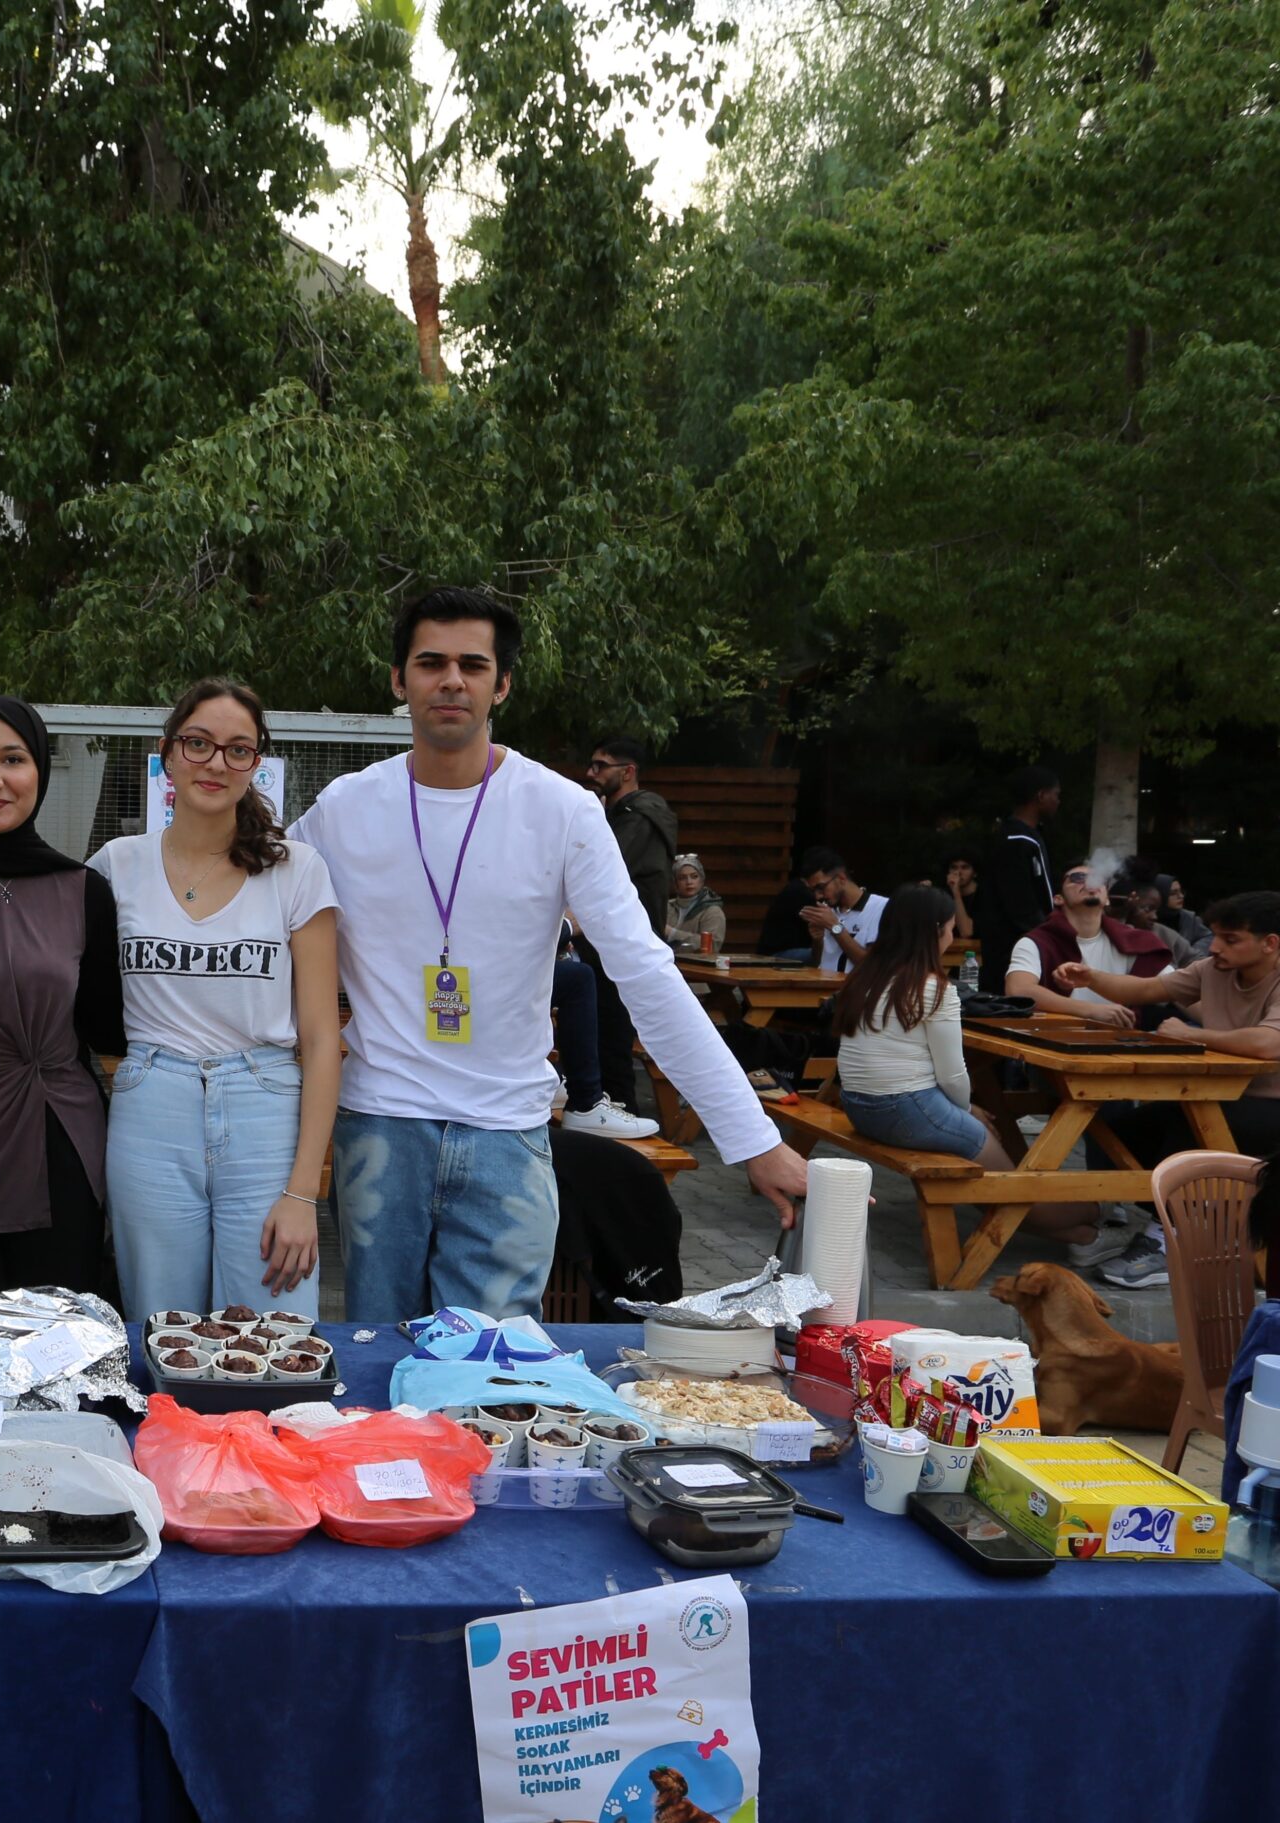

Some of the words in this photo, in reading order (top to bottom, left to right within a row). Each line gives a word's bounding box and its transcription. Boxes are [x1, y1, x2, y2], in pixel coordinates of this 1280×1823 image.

[121, 940, 278, 974] RESPECT
[428, 1001, 469, 1012] Saturdays
[434, 991, 460, 1001] Happy
[955, 1384, 1015, 1421] nly
[946, 1455, 968, 1470] 30
[1123, 1506, 1175, 1544] 20
[1158, 1544, 1172, 1552] TL
[1194, 1547, 1207, 1555] 100
[507, 1623, 649, 1681] SEVİMLİ
[511, 1666, 658, 1719] PATİLER
[514, 1711, 610, 1742] KERMESİMİZ
[516, 1739, 571, 1760] SOKAK
[518, 1749, 620, 1777] HAYVANLARI
[520, 1776, 581, 1798] İÇİNDİR
